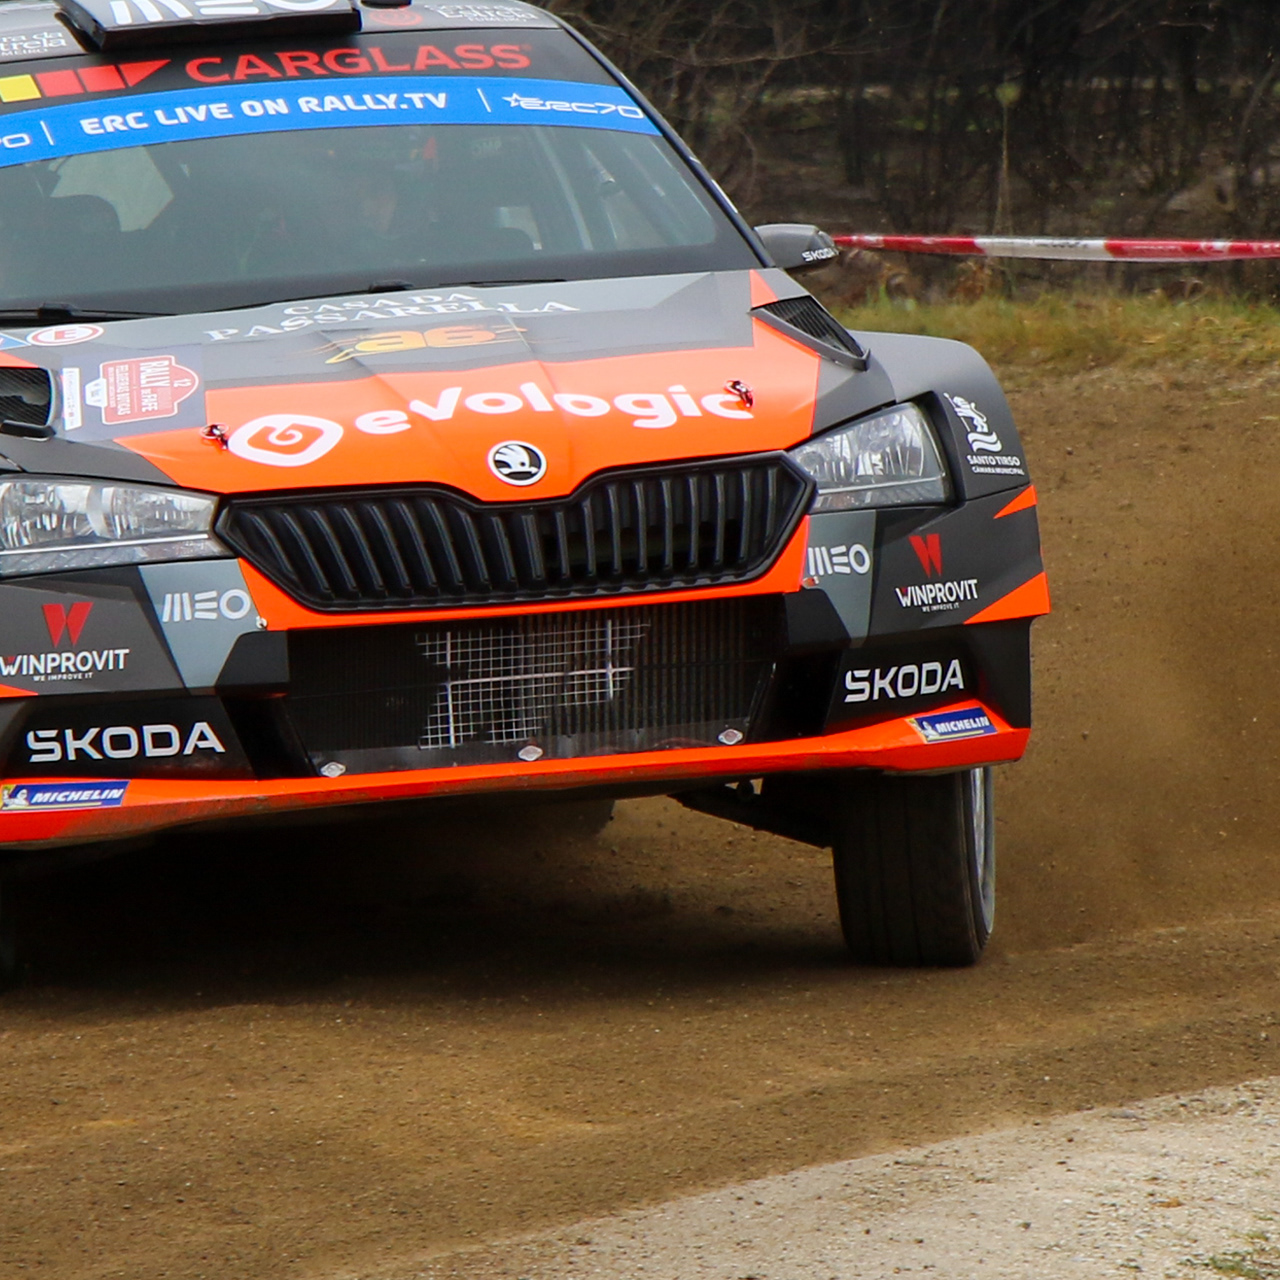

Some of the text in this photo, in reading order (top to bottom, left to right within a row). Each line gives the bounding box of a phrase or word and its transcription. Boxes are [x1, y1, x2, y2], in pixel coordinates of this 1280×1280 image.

[37, 30, 64, 41] da
[184, 43, 532, 85] CARGLASS
[80, 92, 447, 136] ERC LIVE ON RALLY.TV
[283, 292, 478, 316] CASA DA
[203, 300, 581, 342] PASSARELLA
[140, 360, 170, 388] RALLY
[173, 377, 191, 389] 12
[141, 393, 159, 413] FAFE
[355, 381, 754, 435] evologic
[967, 454, 1020, 466] SANTO TIRSO
[807, 543, 871, 576] MEO
[162, 588, 252, 623] MEO
[894, 578, 980, 608] WINPROVIT
[33, 671, 93, 682] WE IMPROVE IT
[843, 658, 965, 703] SKODA
[934, 715, 991, 734] MICHELIN
[26, 721, 226, 763] SKODA
[30, 787, 124, 804] MICHELIN
